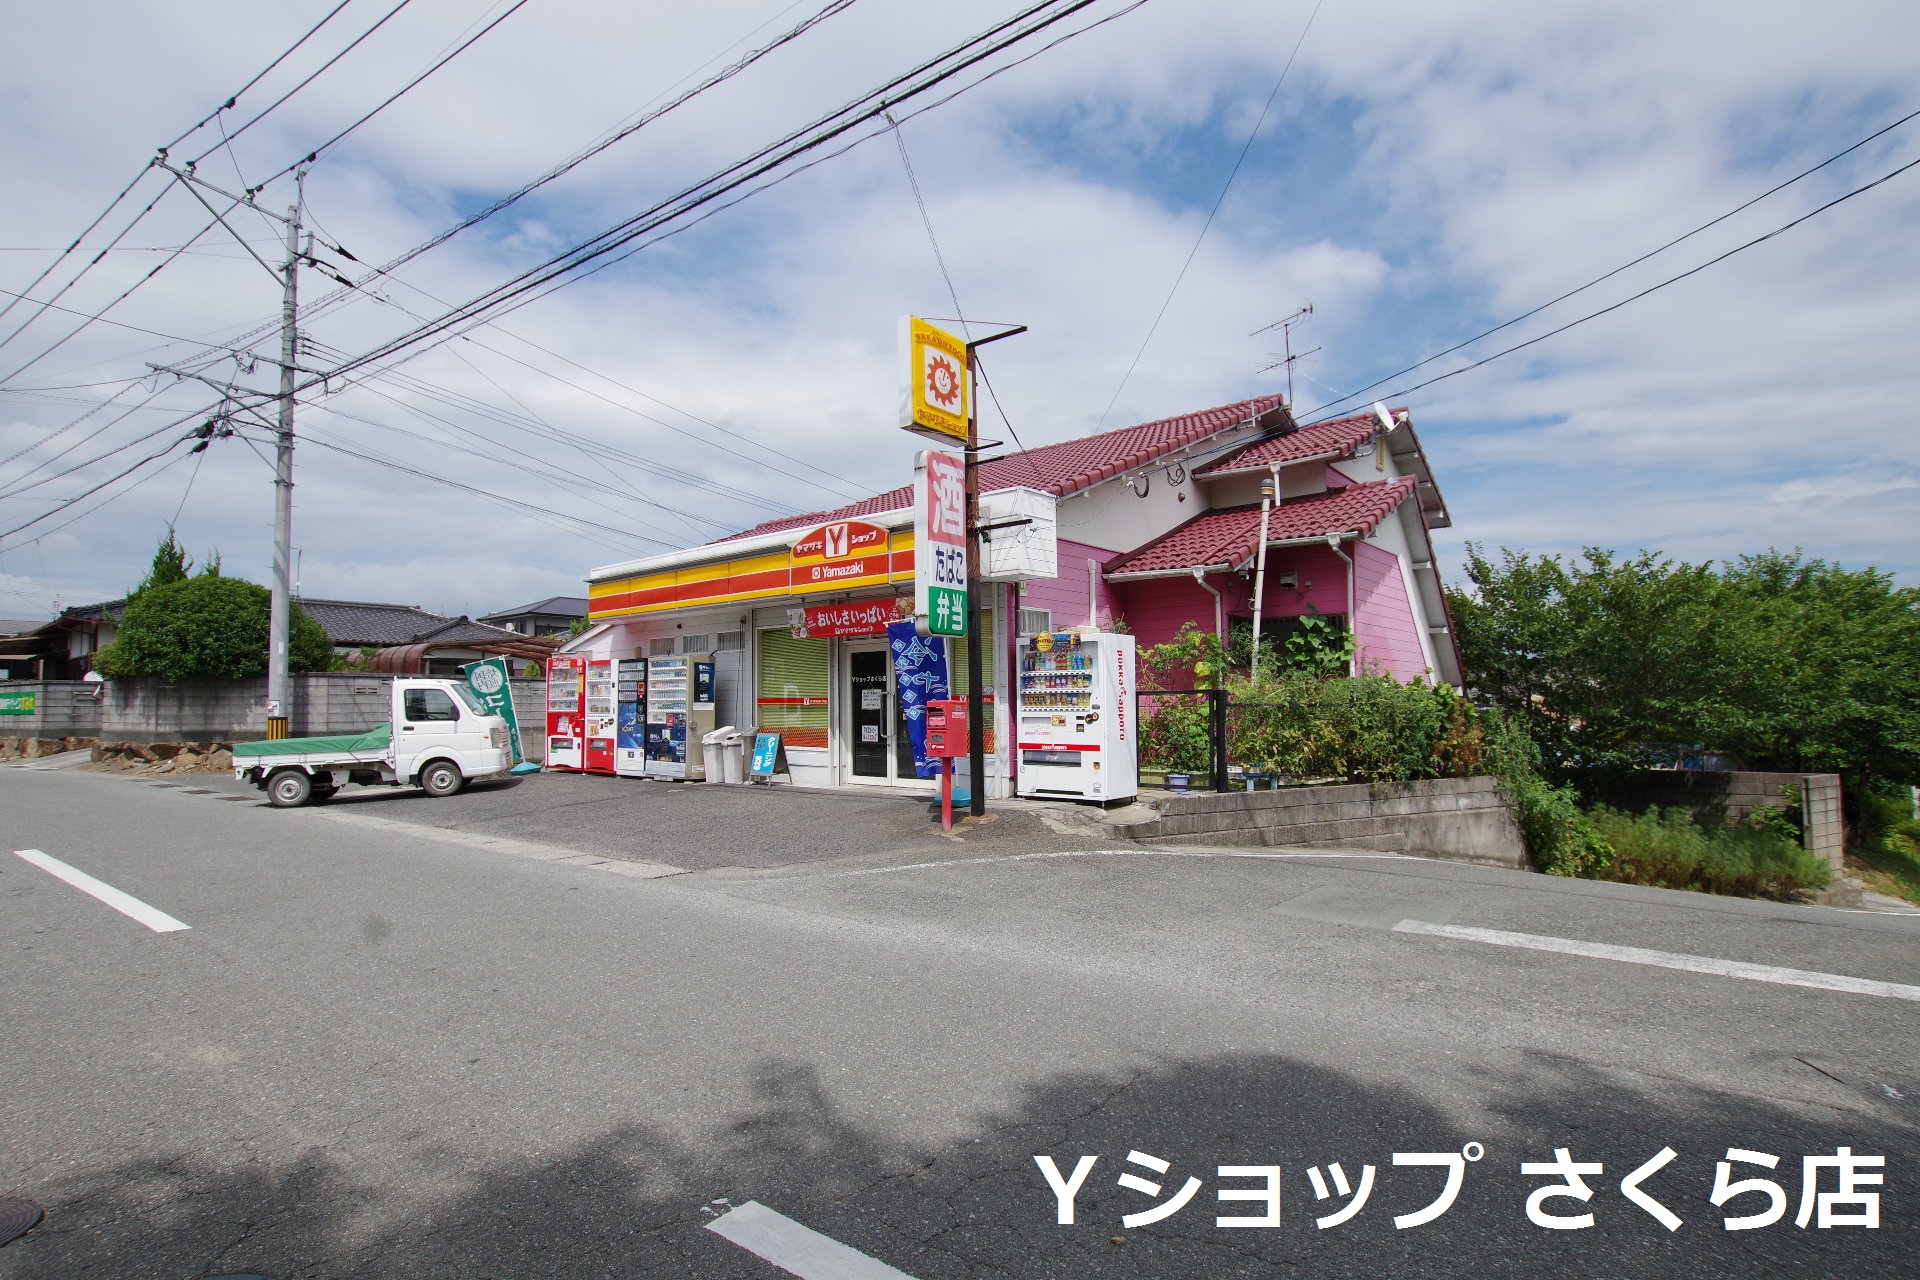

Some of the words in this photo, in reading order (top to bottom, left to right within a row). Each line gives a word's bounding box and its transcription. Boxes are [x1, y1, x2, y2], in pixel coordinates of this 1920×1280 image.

[932, 459, 965, 537] 酒
[796, 541, 824, 554] ヤマザキ
[827, 525, 846, 555] Y
[851, 530, 878, 545] ショップ
[822, 561, 864, 578] Yamazaki
[935, 545, 964, 586] たばこ
[817, 606, 885, 627] おいしさいっぱい
[937, 590, 963, 632] 弁当
[763, 736, 776, 767] クリーニング
